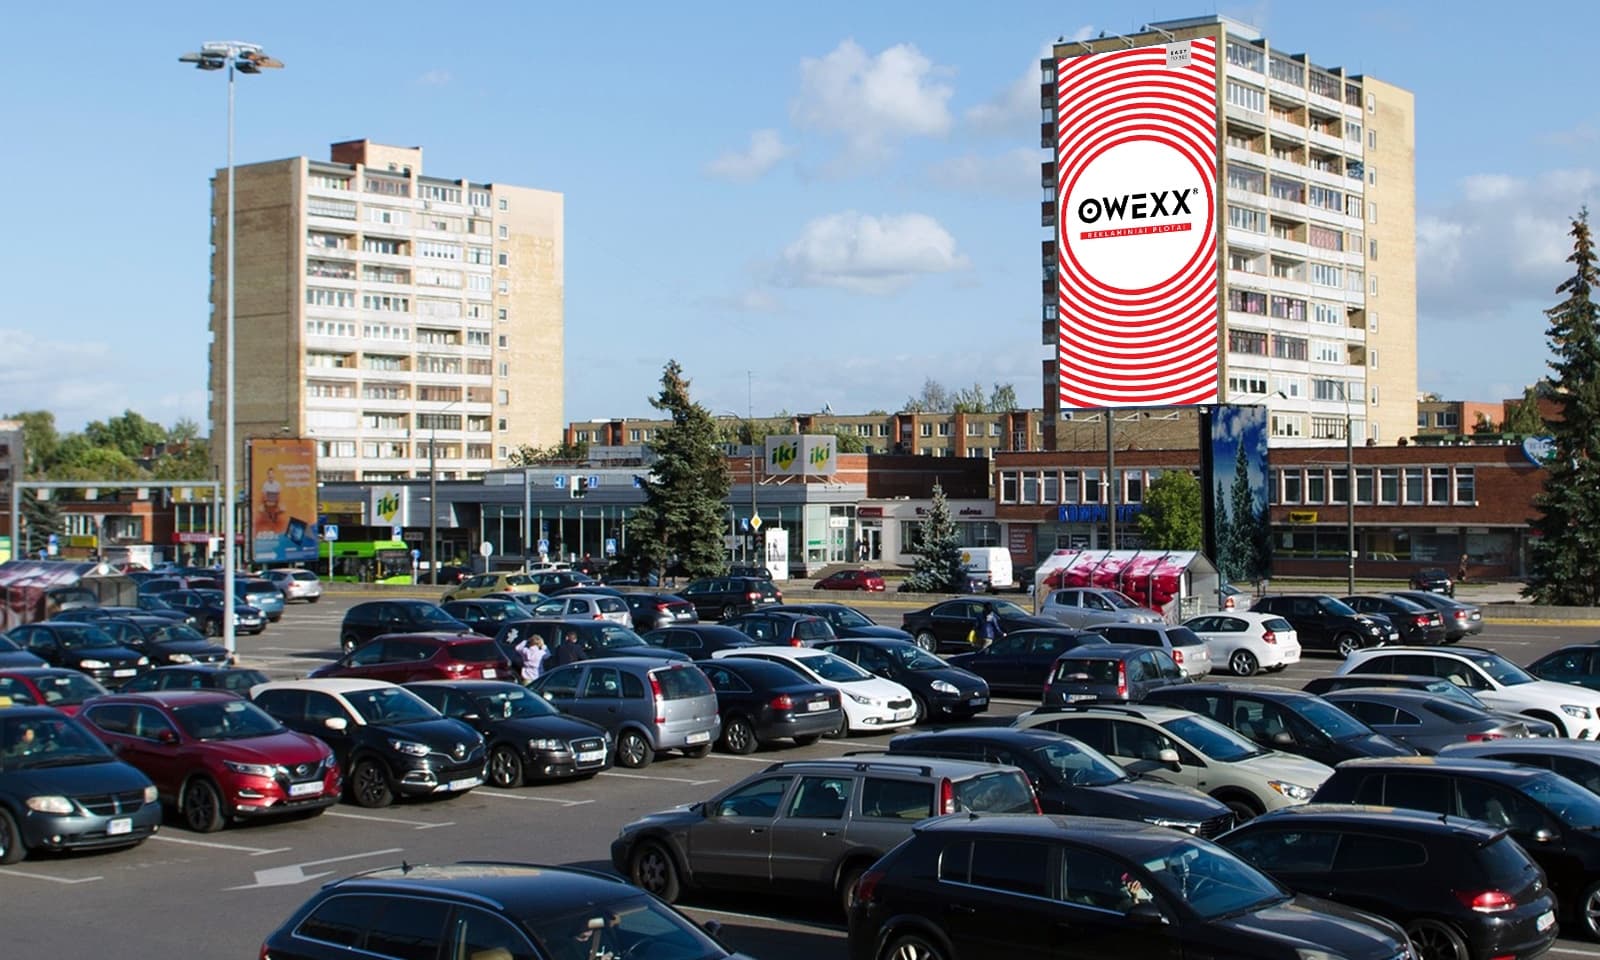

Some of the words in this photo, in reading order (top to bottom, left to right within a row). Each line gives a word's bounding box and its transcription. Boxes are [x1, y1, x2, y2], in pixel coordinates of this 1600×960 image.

[1087, 227, 1148, 239] REKLAMINIAI
[1152, 224, 1186, 233] PLOTAI
[771, 441, 798, 465] iki
[809, 442, 830, 465] iki
[377, 493, 400, 516] iki
